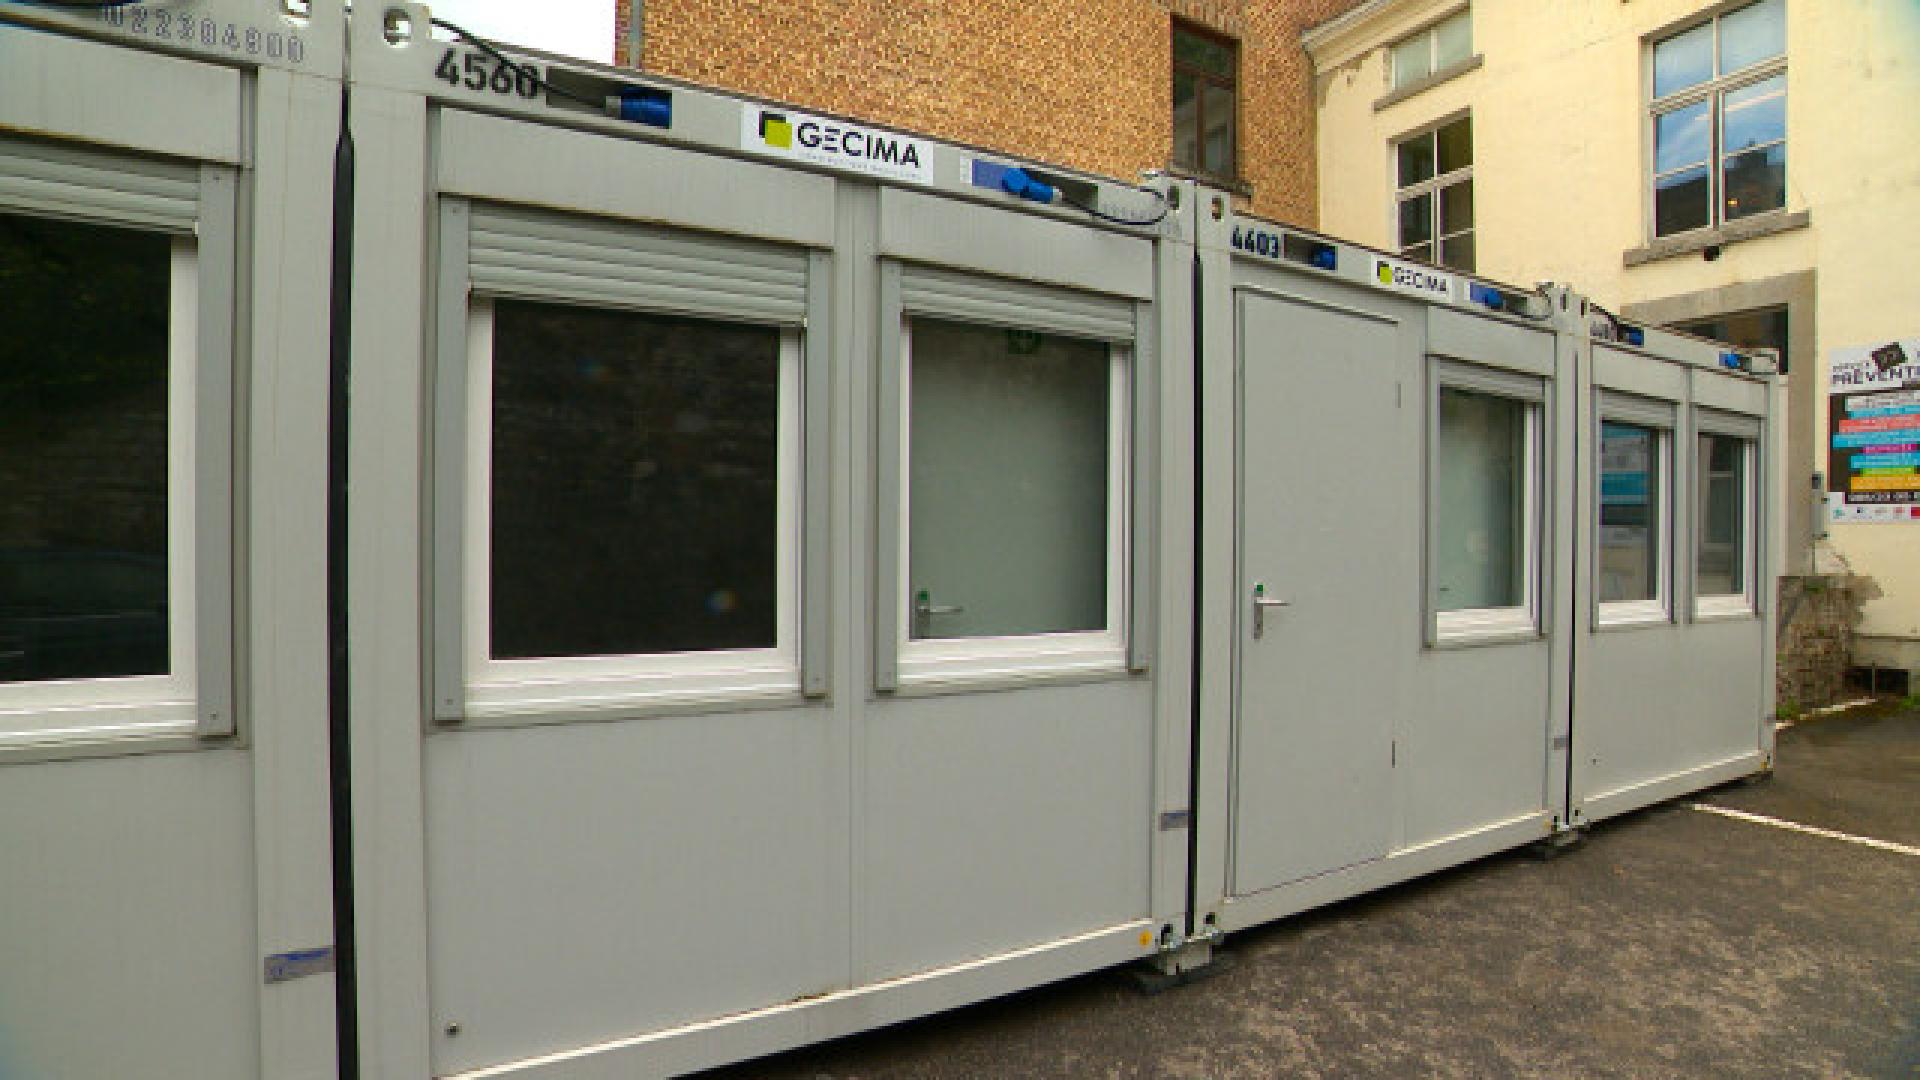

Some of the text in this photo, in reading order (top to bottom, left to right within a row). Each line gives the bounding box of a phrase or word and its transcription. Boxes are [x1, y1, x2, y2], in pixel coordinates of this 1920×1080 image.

[434, 48, 538, 99] 4560
[797, 122, 920, 168] GECIMA
[1232, 225, 1279, 258] 4403
